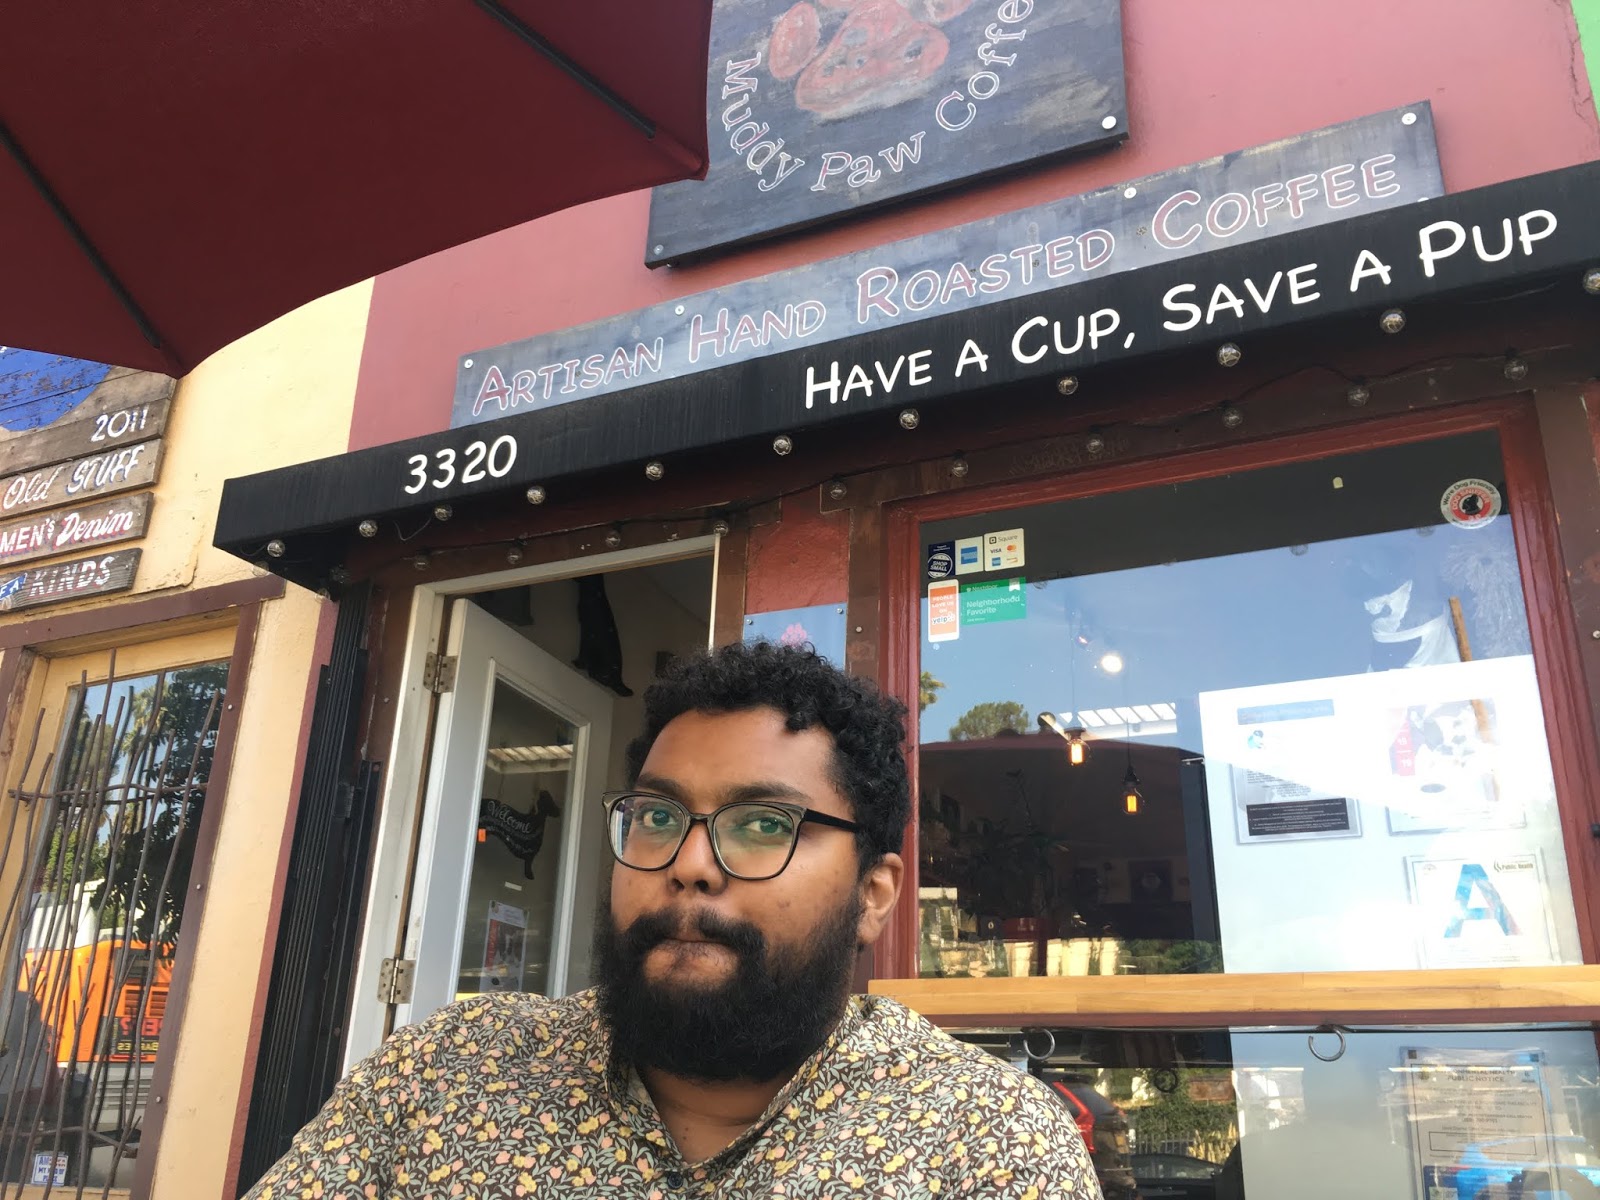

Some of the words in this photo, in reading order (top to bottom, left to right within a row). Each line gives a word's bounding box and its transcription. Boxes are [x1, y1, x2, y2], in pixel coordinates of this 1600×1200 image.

[721, 52, 804, 192] Muddy
[811, 132, 926, 192] Paw
[472, 337, 664, 416] ARTISAN
[688, 300, 826, 363] HAND
[857, 229, 1115, 324] ROASTED
[1152, 154, 1400, 249] COFFEE
[805, 350, 933, 409] HAVE
[955, 339, 988, 377] A
[1163, 263, 1321, 332] SAVE
[1349, 249, 1392, 292] A
[1419, 209, 1558, 277] PUP
[90, 405, 149, 442] 2011
[404, 434, 518, 494] 3320
[2, 467, 63, 510] Old
[55, 510, 133, 546] Denim
[29, 556, 115, 596] KINDS
[966, 596, 1020, 608] Neighborhood
[966, 607, 997, 616] Favorite
[1444, 864, 1521, 938] A
